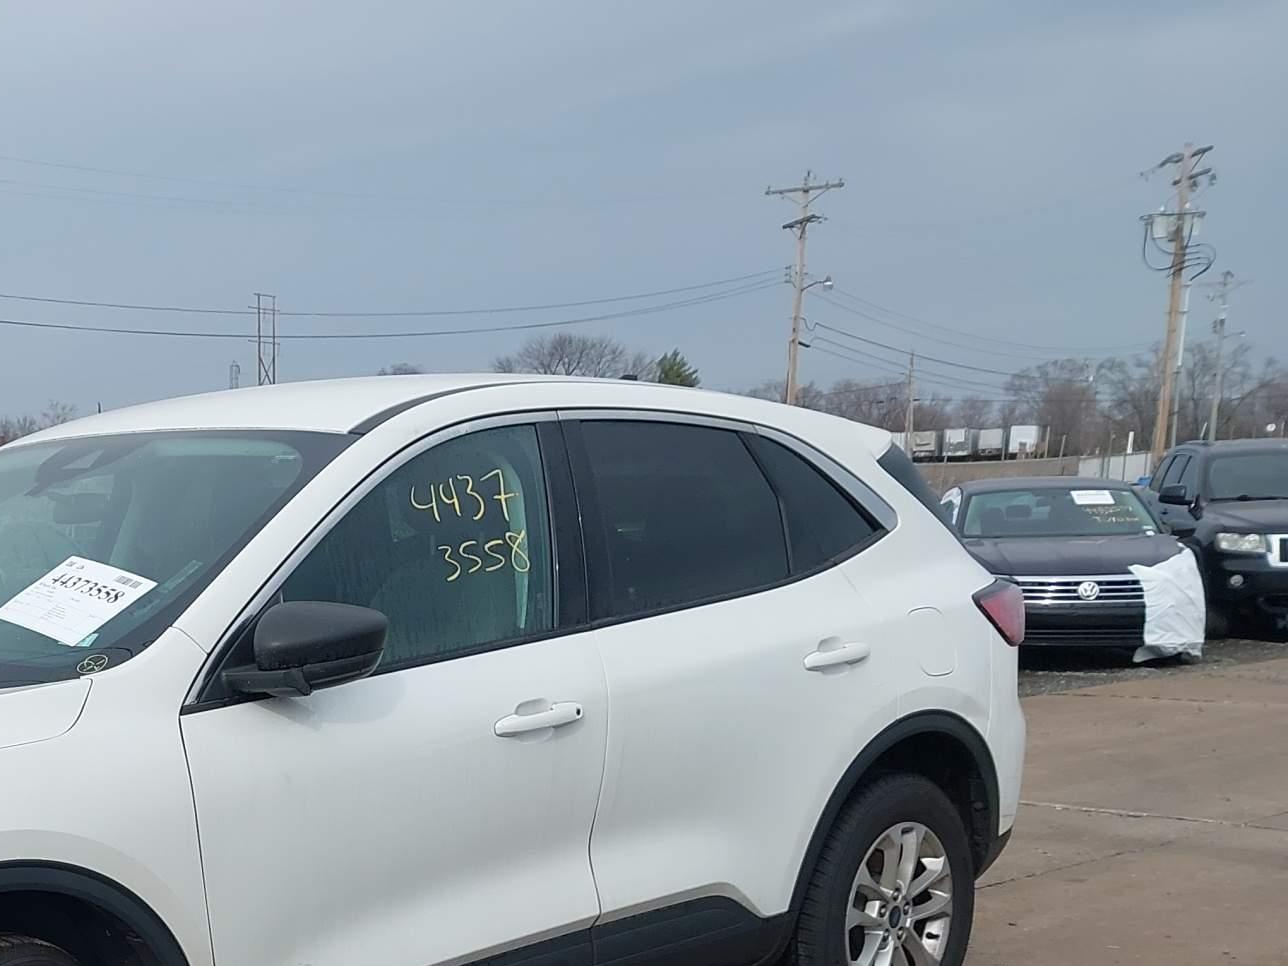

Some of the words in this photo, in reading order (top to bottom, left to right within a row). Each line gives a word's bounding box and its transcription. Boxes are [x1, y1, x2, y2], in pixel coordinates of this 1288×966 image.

[409, 468, 520, 523] 4437
[437, 529, 531, 583] 3558
[51, 572, 126, 604] 44373558
